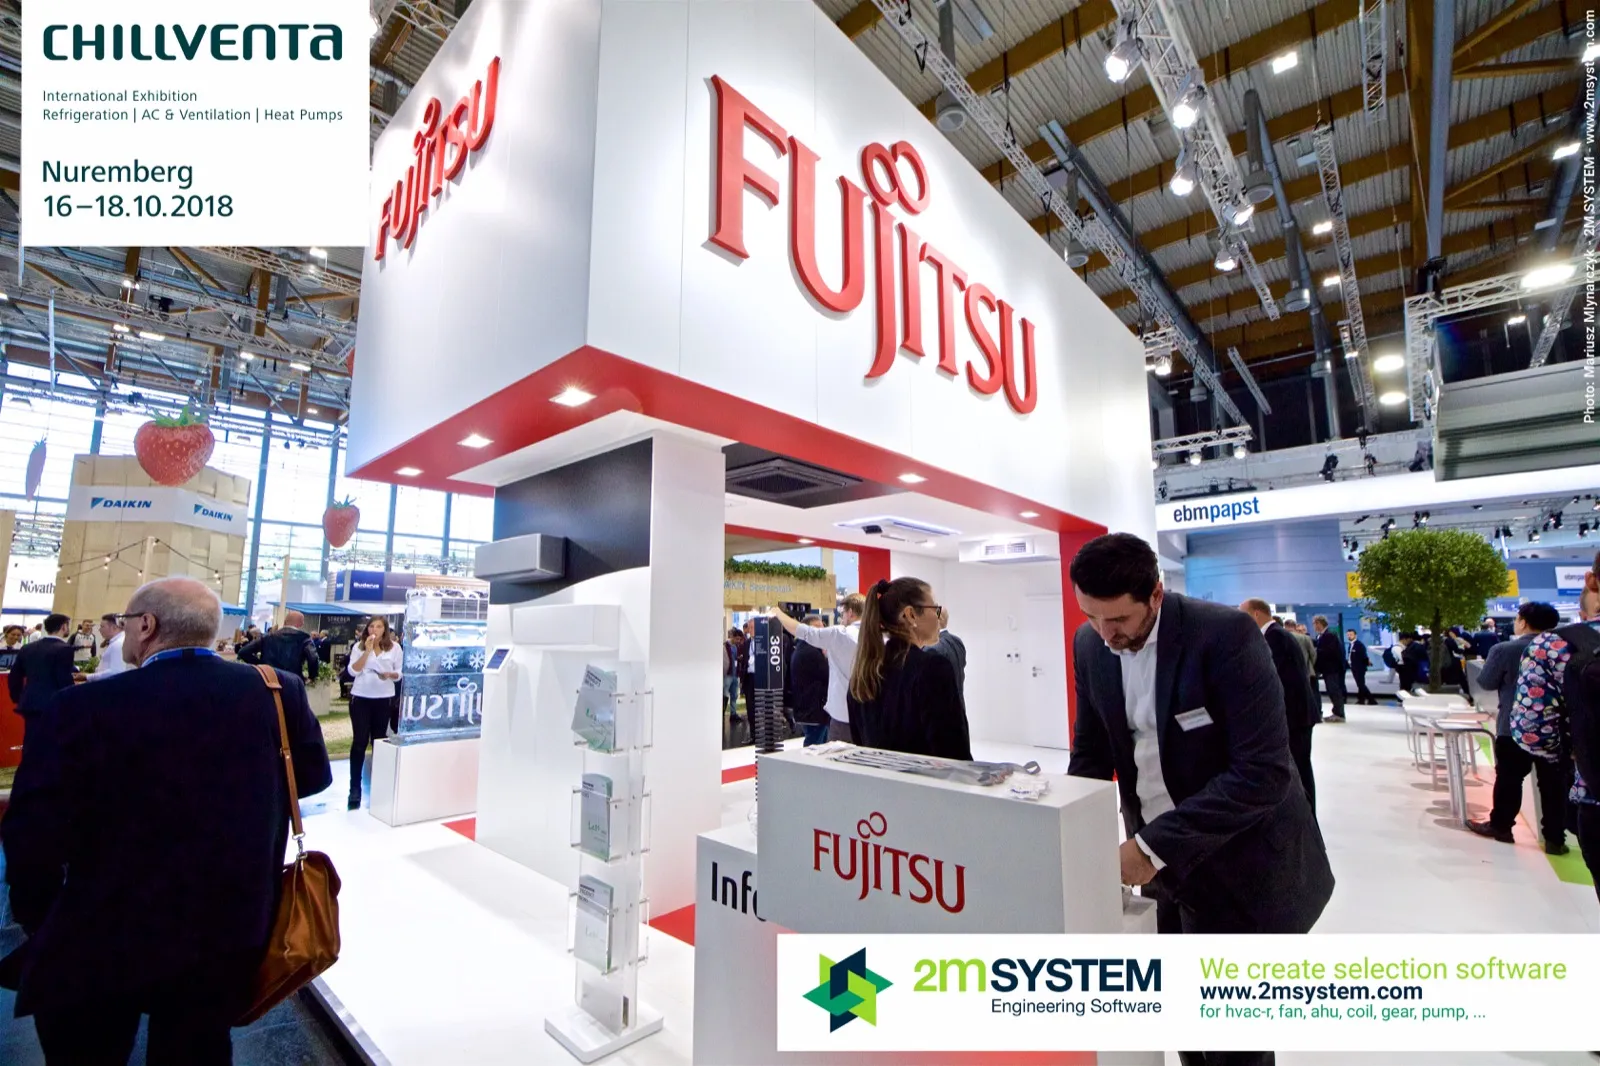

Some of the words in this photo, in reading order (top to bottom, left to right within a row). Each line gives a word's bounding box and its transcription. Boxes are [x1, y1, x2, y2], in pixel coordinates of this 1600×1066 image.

[374, 56, 500, 261] FUJITSU
[708, 74, 1037, 414] FUJITSU
[103, 499, 152, 508] DAIKIN
[202, 508, 233, 521] DAIKIN
[1173, 496, 1260, 523] ebmpapst
[769, 635, 781, 672] 360°
[813, 811, 966, 914] FUJITSU
